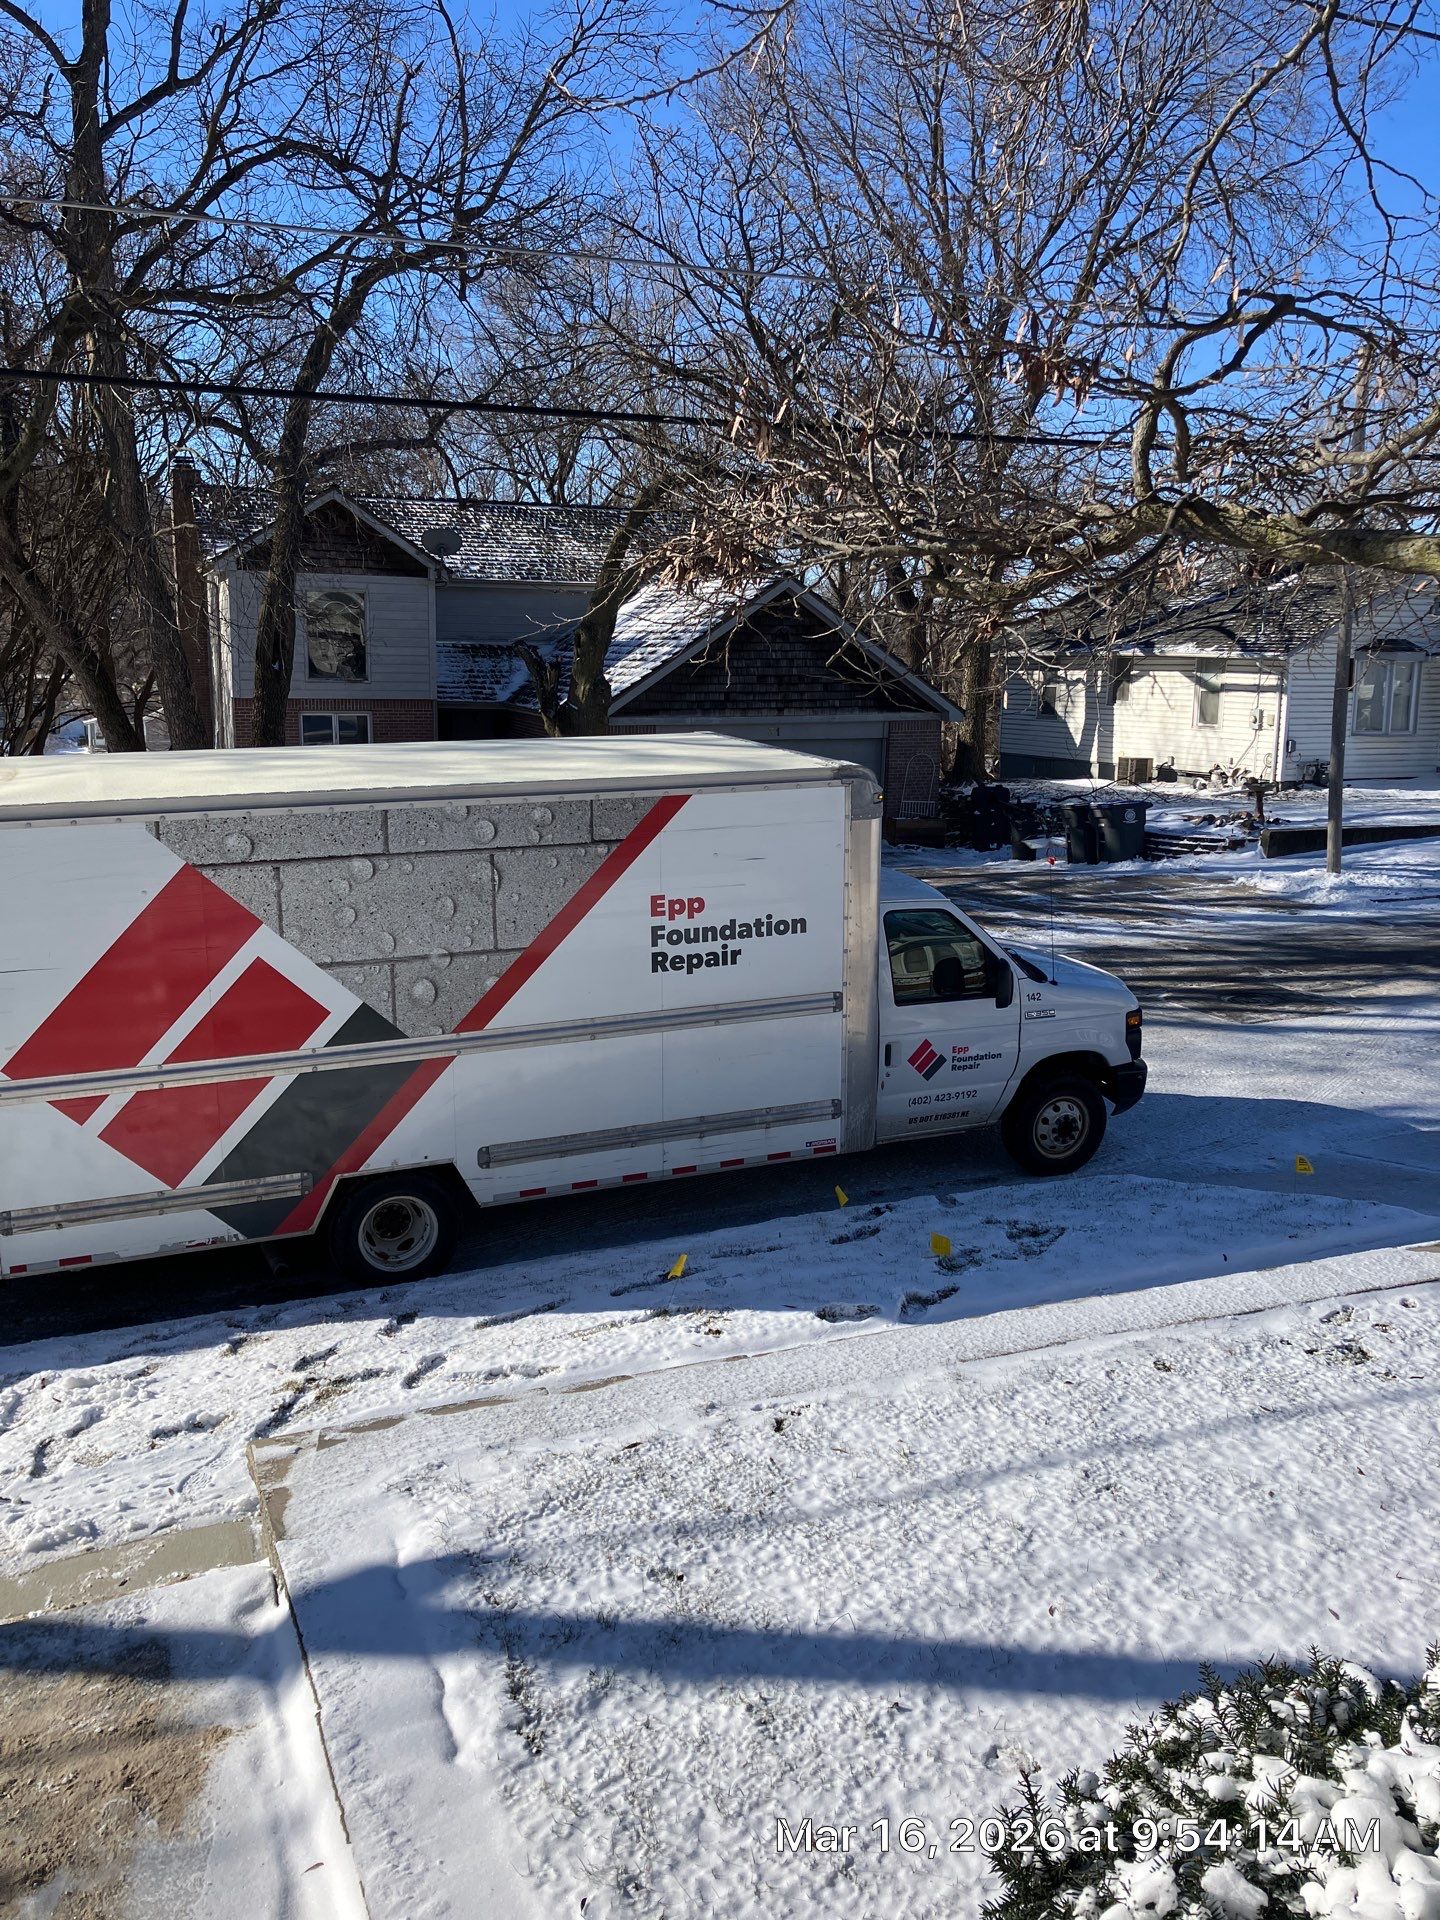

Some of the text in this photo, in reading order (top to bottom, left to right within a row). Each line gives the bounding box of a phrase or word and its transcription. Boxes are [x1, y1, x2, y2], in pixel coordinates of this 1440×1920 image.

[650, 894, 706, 921] Epp
[650, 913, 807, 947] Foundation
[651, 943, 742, 975] Repair
[1026, 992, 1042, 1002] 142
[952, 1046, 969, 1055] Epp
[952, 1052, 1002, 1063] Foundation
[951, 1062, 980, 1072] Repair
[908, 1090, 978, 1108] (402) 423-9192
[908, 1116, 918, 1124] US
[919, 1115, 935, 1123] DOT
